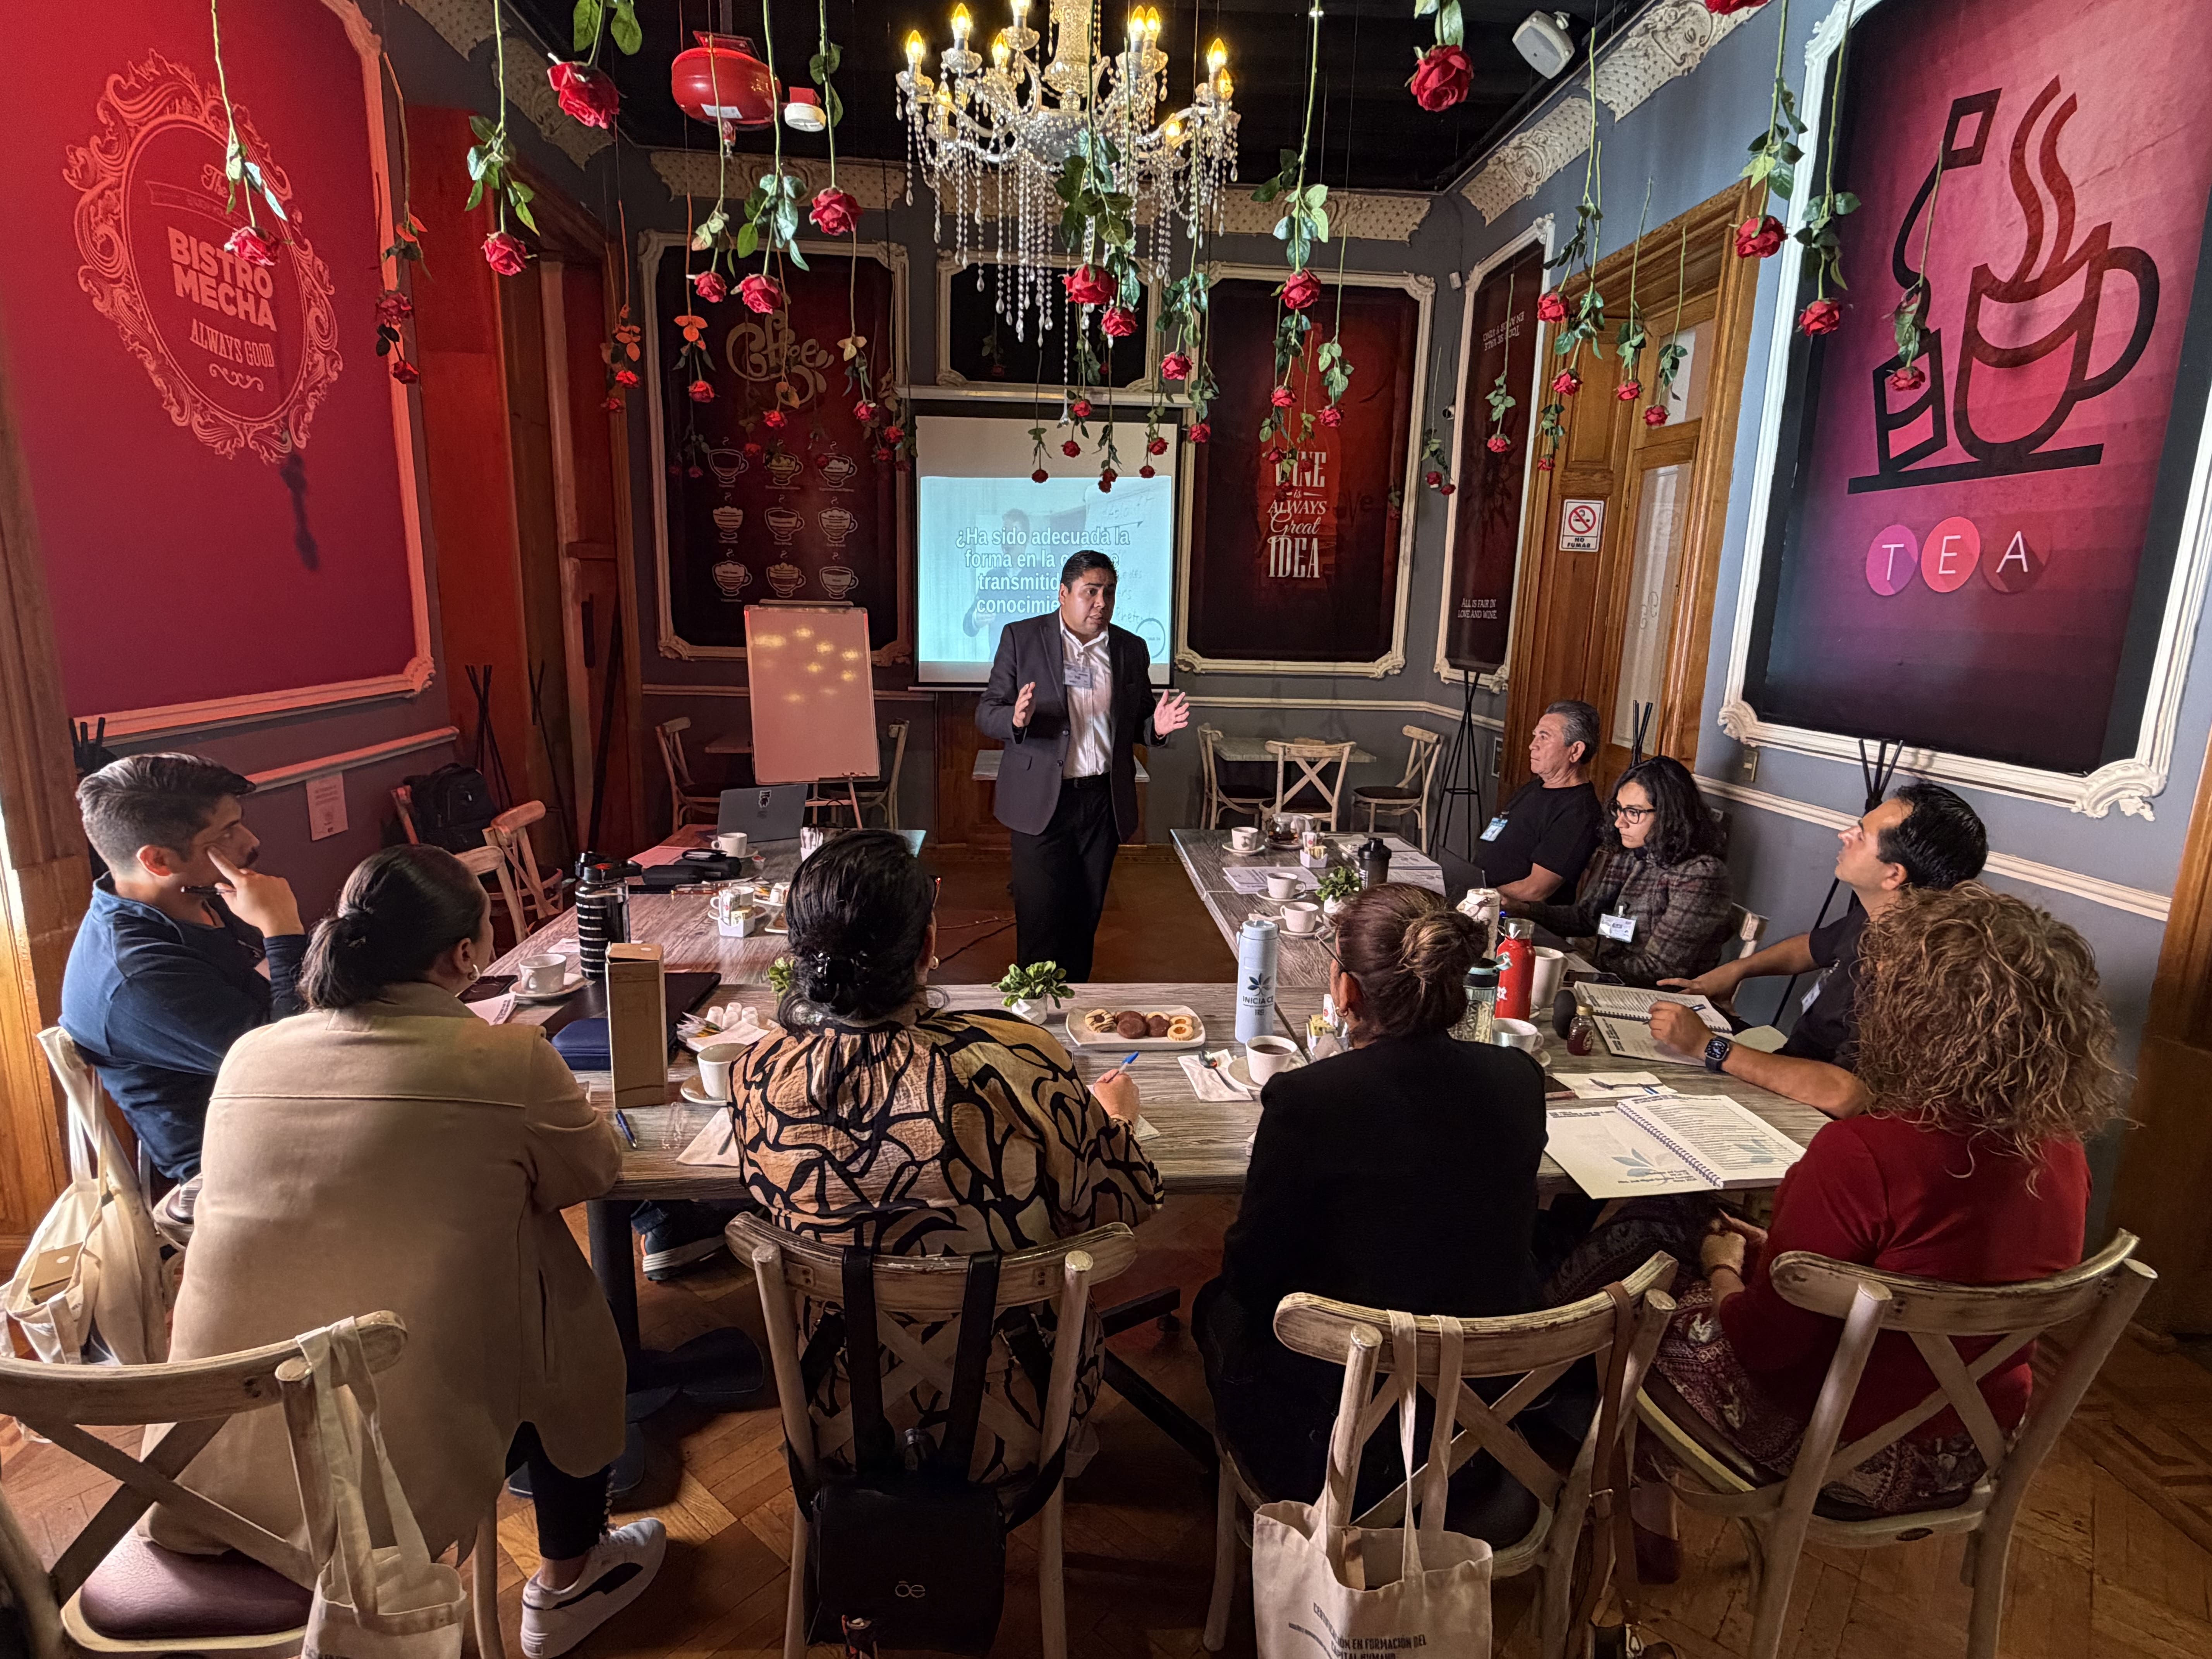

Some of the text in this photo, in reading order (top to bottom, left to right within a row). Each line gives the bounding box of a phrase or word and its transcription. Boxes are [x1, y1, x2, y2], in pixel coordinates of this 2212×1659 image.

[168, 226, 273, 298] BISTRO
[173, 263, 277, 331] MECHA
[190, 318, 243, 363] ALWAYS
[244, 340, 275, 368] GOOD
[1294, 489, 1302, 498] is
[1267, 500, 1327, 514] ALWAYS
[956, 526, 1130, 548] ¿Ha sido adecuada la
[1267, 511, 1321, 544] Great
[965, 549, 1012, 568] forma
[1017, 553, 1036, 568] en
[1041, 549, 1056, 568] la
[1268, 538, 1320, 578] IDEA
[979, 572, 1060, 591] transmitid
[977, 595, 1060, 613] conocimie
[1353, 1639, 1362, 1649] EN
